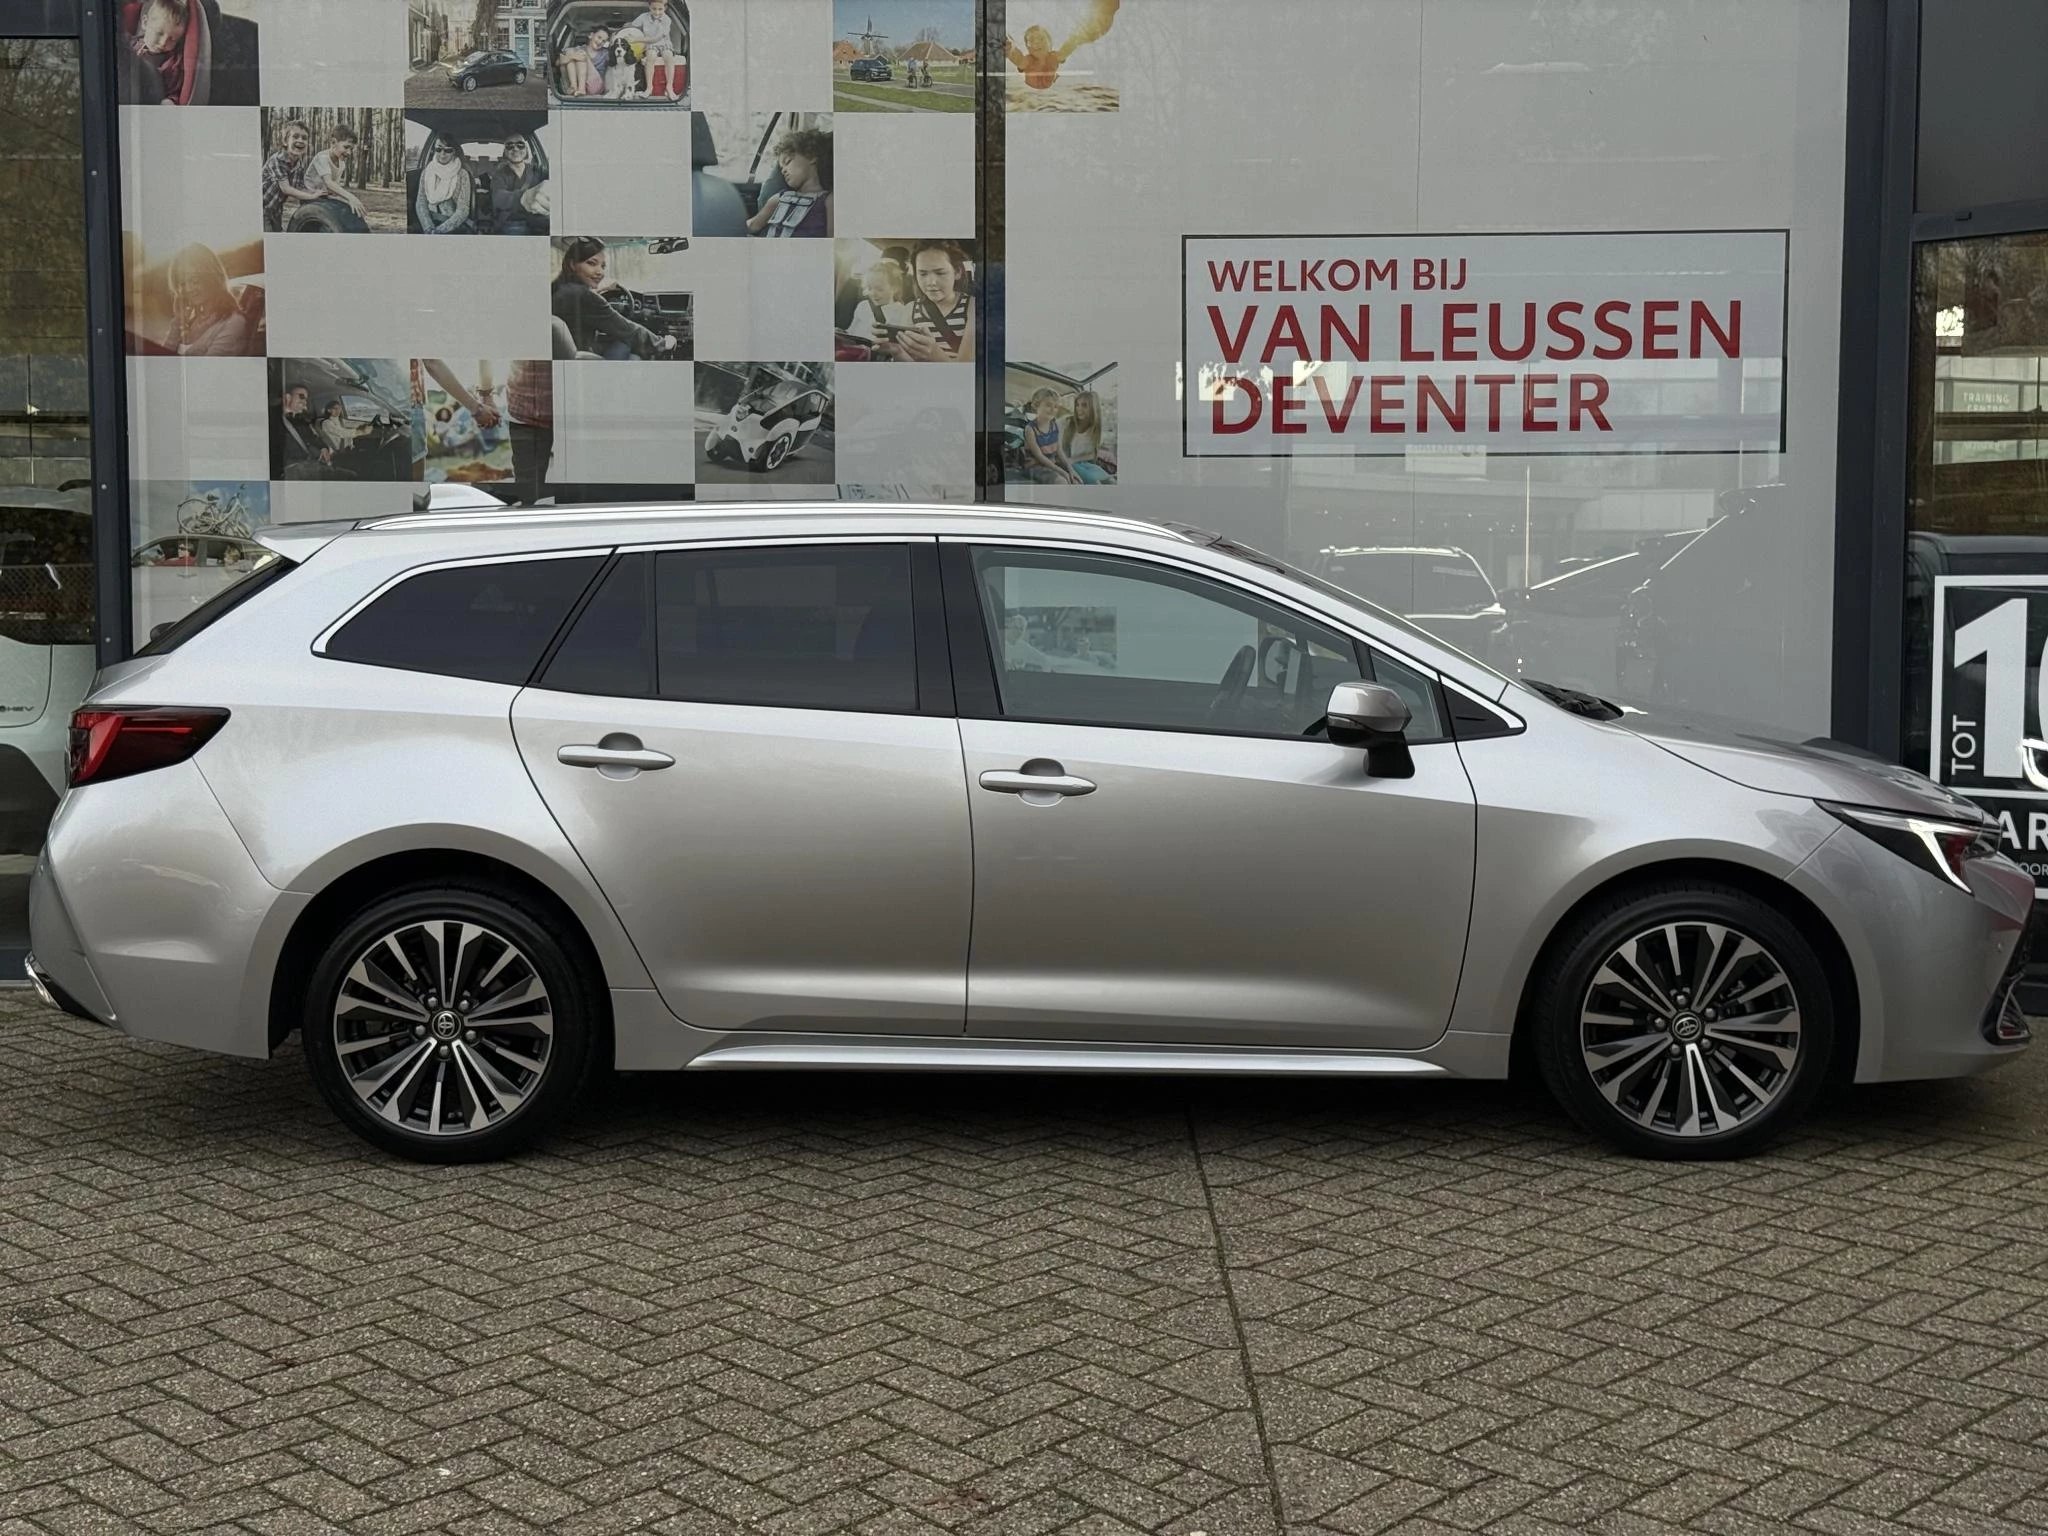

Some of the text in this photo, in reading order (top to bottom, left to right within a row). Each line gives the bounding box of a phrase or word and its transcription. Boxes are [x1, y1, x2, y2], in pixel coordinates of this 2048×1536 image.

[1207, 258, 1467, 292] WELKOM BIJ
[1207, 300, 1742, 364] VAN LEUSSEN
[1212, 373, 1613, 435] DEVENTER
[1953, 598, 2048, 778] 1
[1952, 715, 1977, 775] TOT
